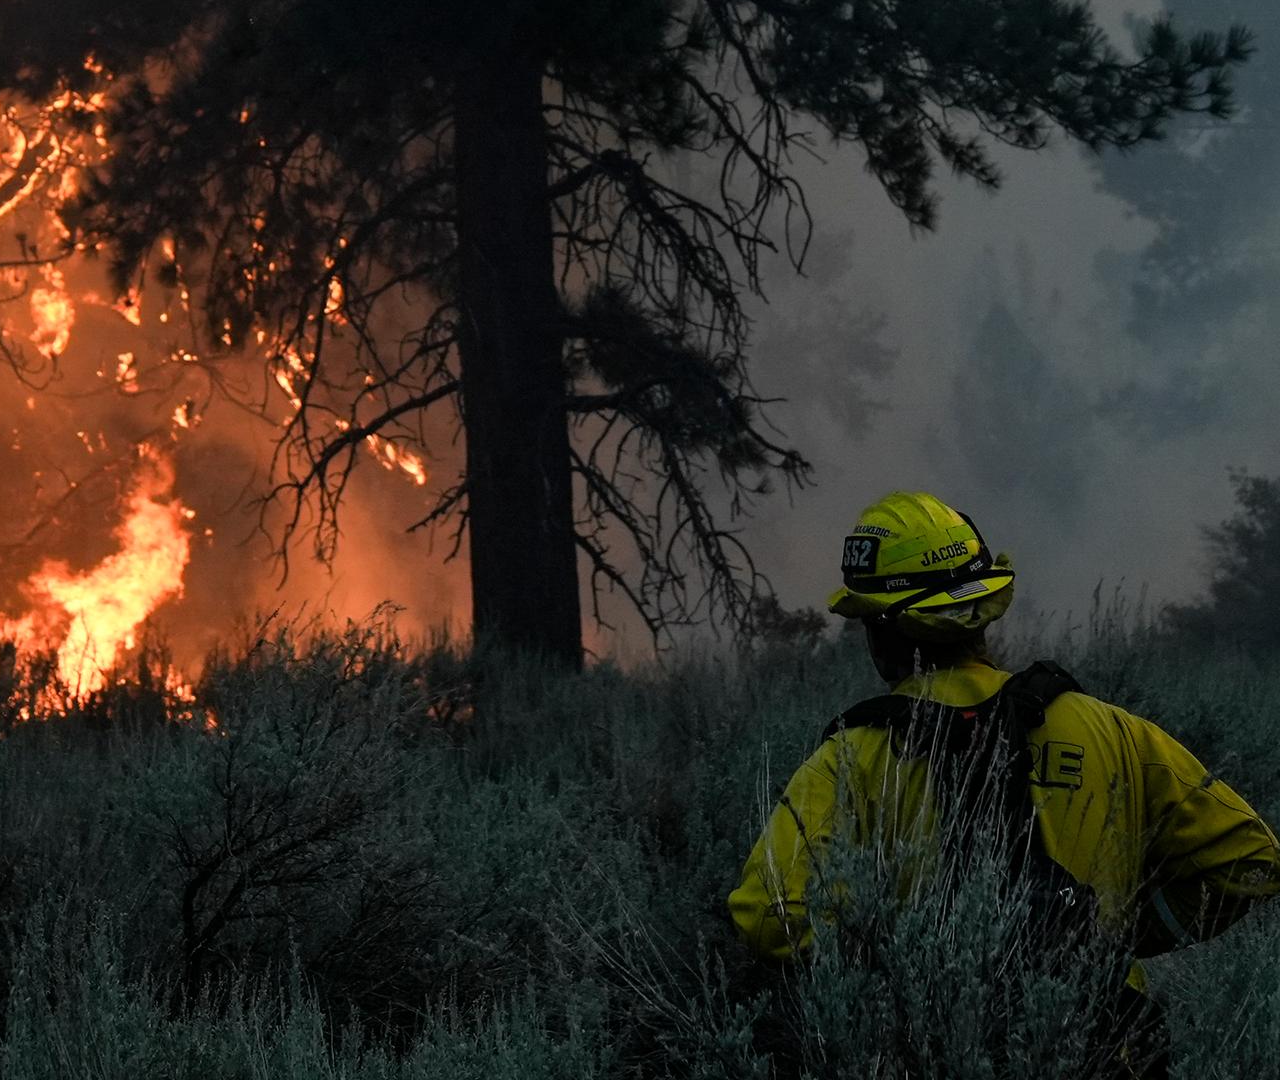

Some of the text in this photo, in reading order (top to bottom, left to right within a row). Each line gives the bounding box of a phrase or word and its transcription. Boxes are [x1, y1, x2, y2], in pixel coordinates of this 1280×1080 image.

[844, 540, 872, 567] 552
[920, 542, 968, 566] JACOBS
[969, 560, 984, 572] PETZL
[885, 578, 911, 591] PETZL
